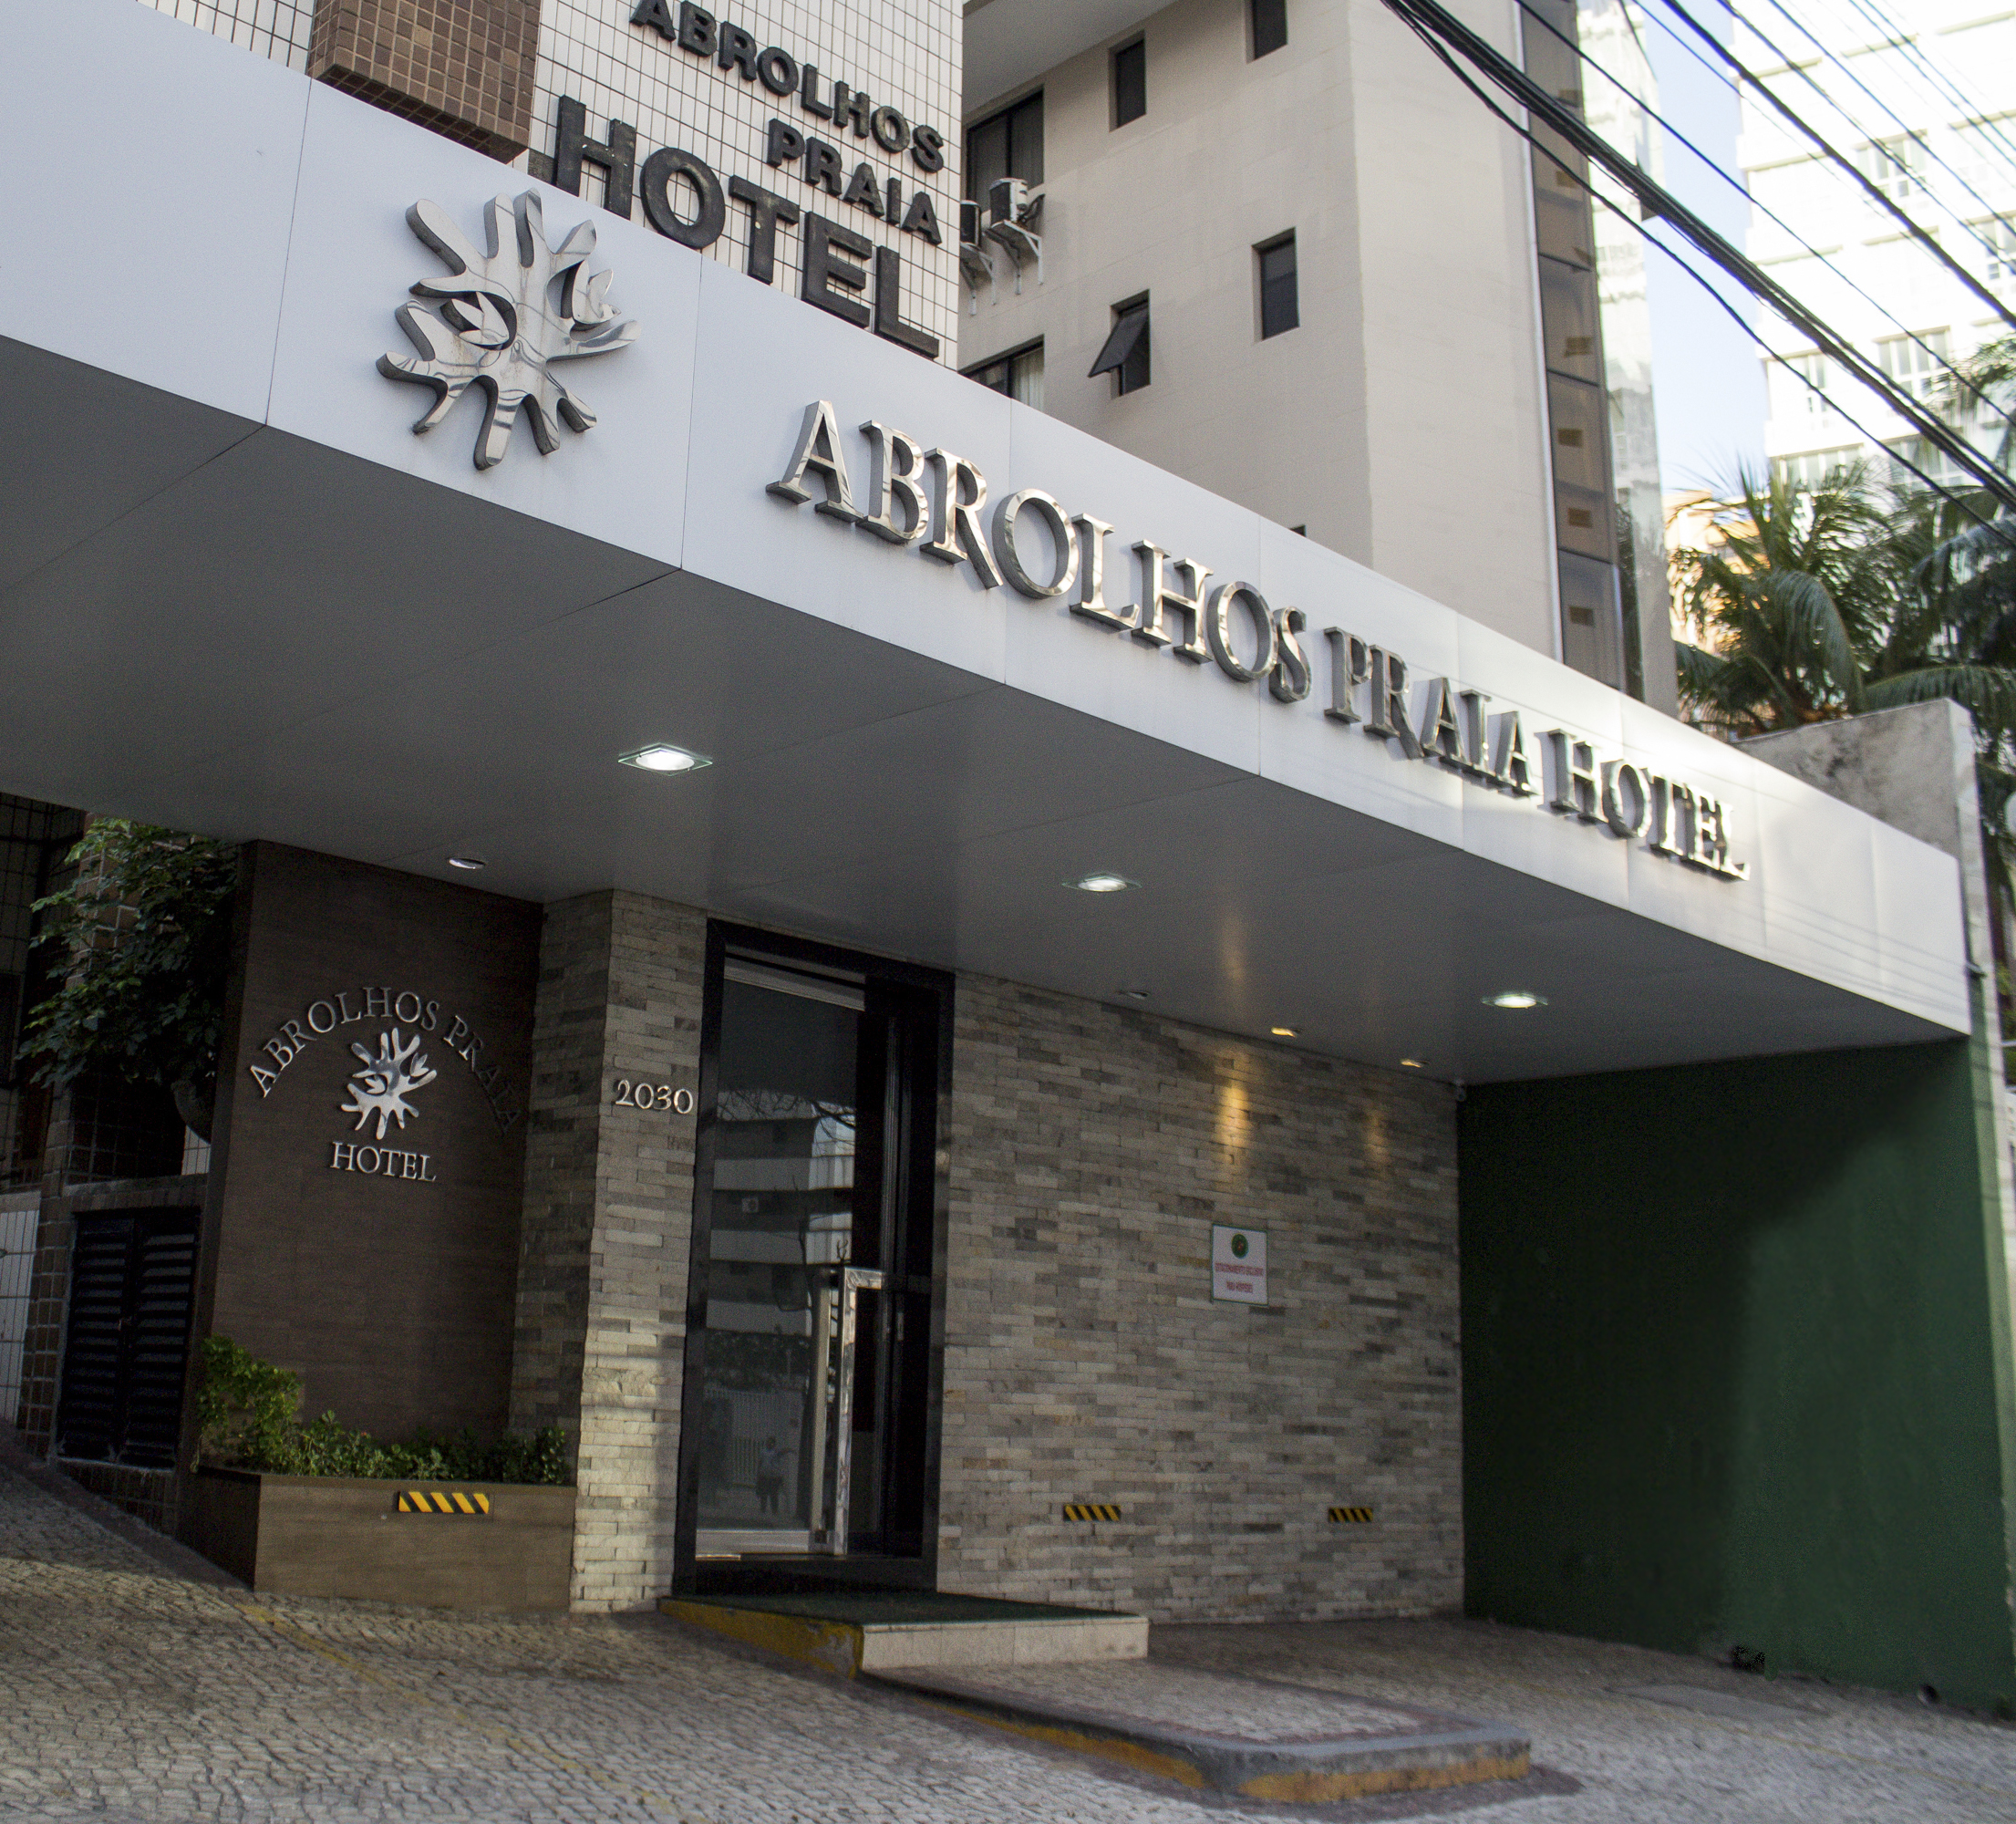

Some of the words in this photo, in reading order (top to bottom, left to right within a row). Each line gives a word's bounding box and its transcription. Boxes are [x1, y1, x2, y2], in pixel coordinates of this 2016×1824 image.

[629, 0, 944, 173] ABROLHOS
[553, 94, 940, 358] HOTEL
[767, 119, 942, 245] PRAIA
[767, 400, 1311, 703] ABROLHOS
[1323, 627, 1540, 800] PRAIA
[1547, 729, 1751, 881] HOTEL
[249, 986, 439, 1097] ABROLHOS
[443, 1007, 522, 1135] PRAIA
[615, 1079, 694, 1114] 2030
[330, 1141, 437, 1182] HOTEL
